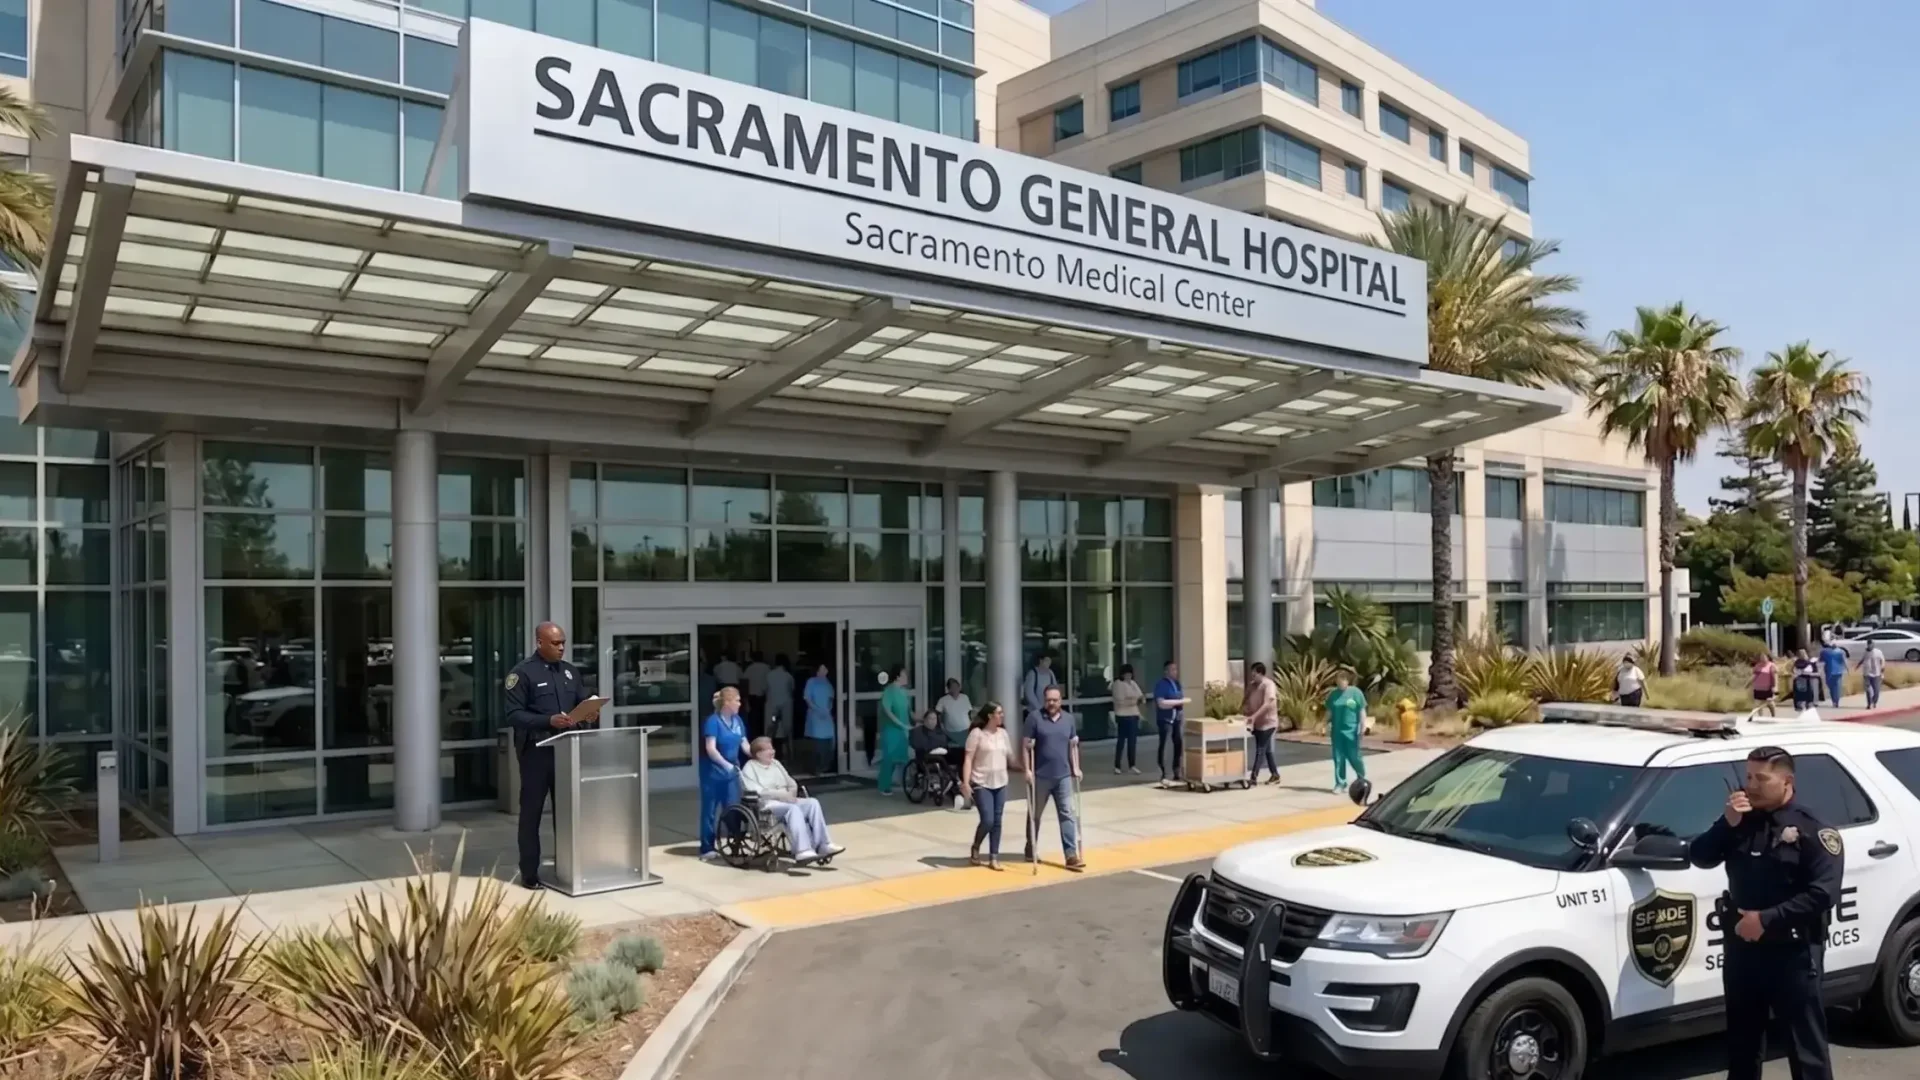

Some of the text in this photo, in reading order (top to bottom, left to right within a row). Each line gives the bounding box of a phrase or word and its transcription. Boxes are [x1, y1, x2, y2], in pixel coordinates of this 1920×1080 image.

[534, 56, 1406, 305] SACRAMENTO GENERAL HOSPITAL
[846, 211, 1255, 319] Sacramento Medical Center
[1556, 888, 1607, 908] UNIT 51
